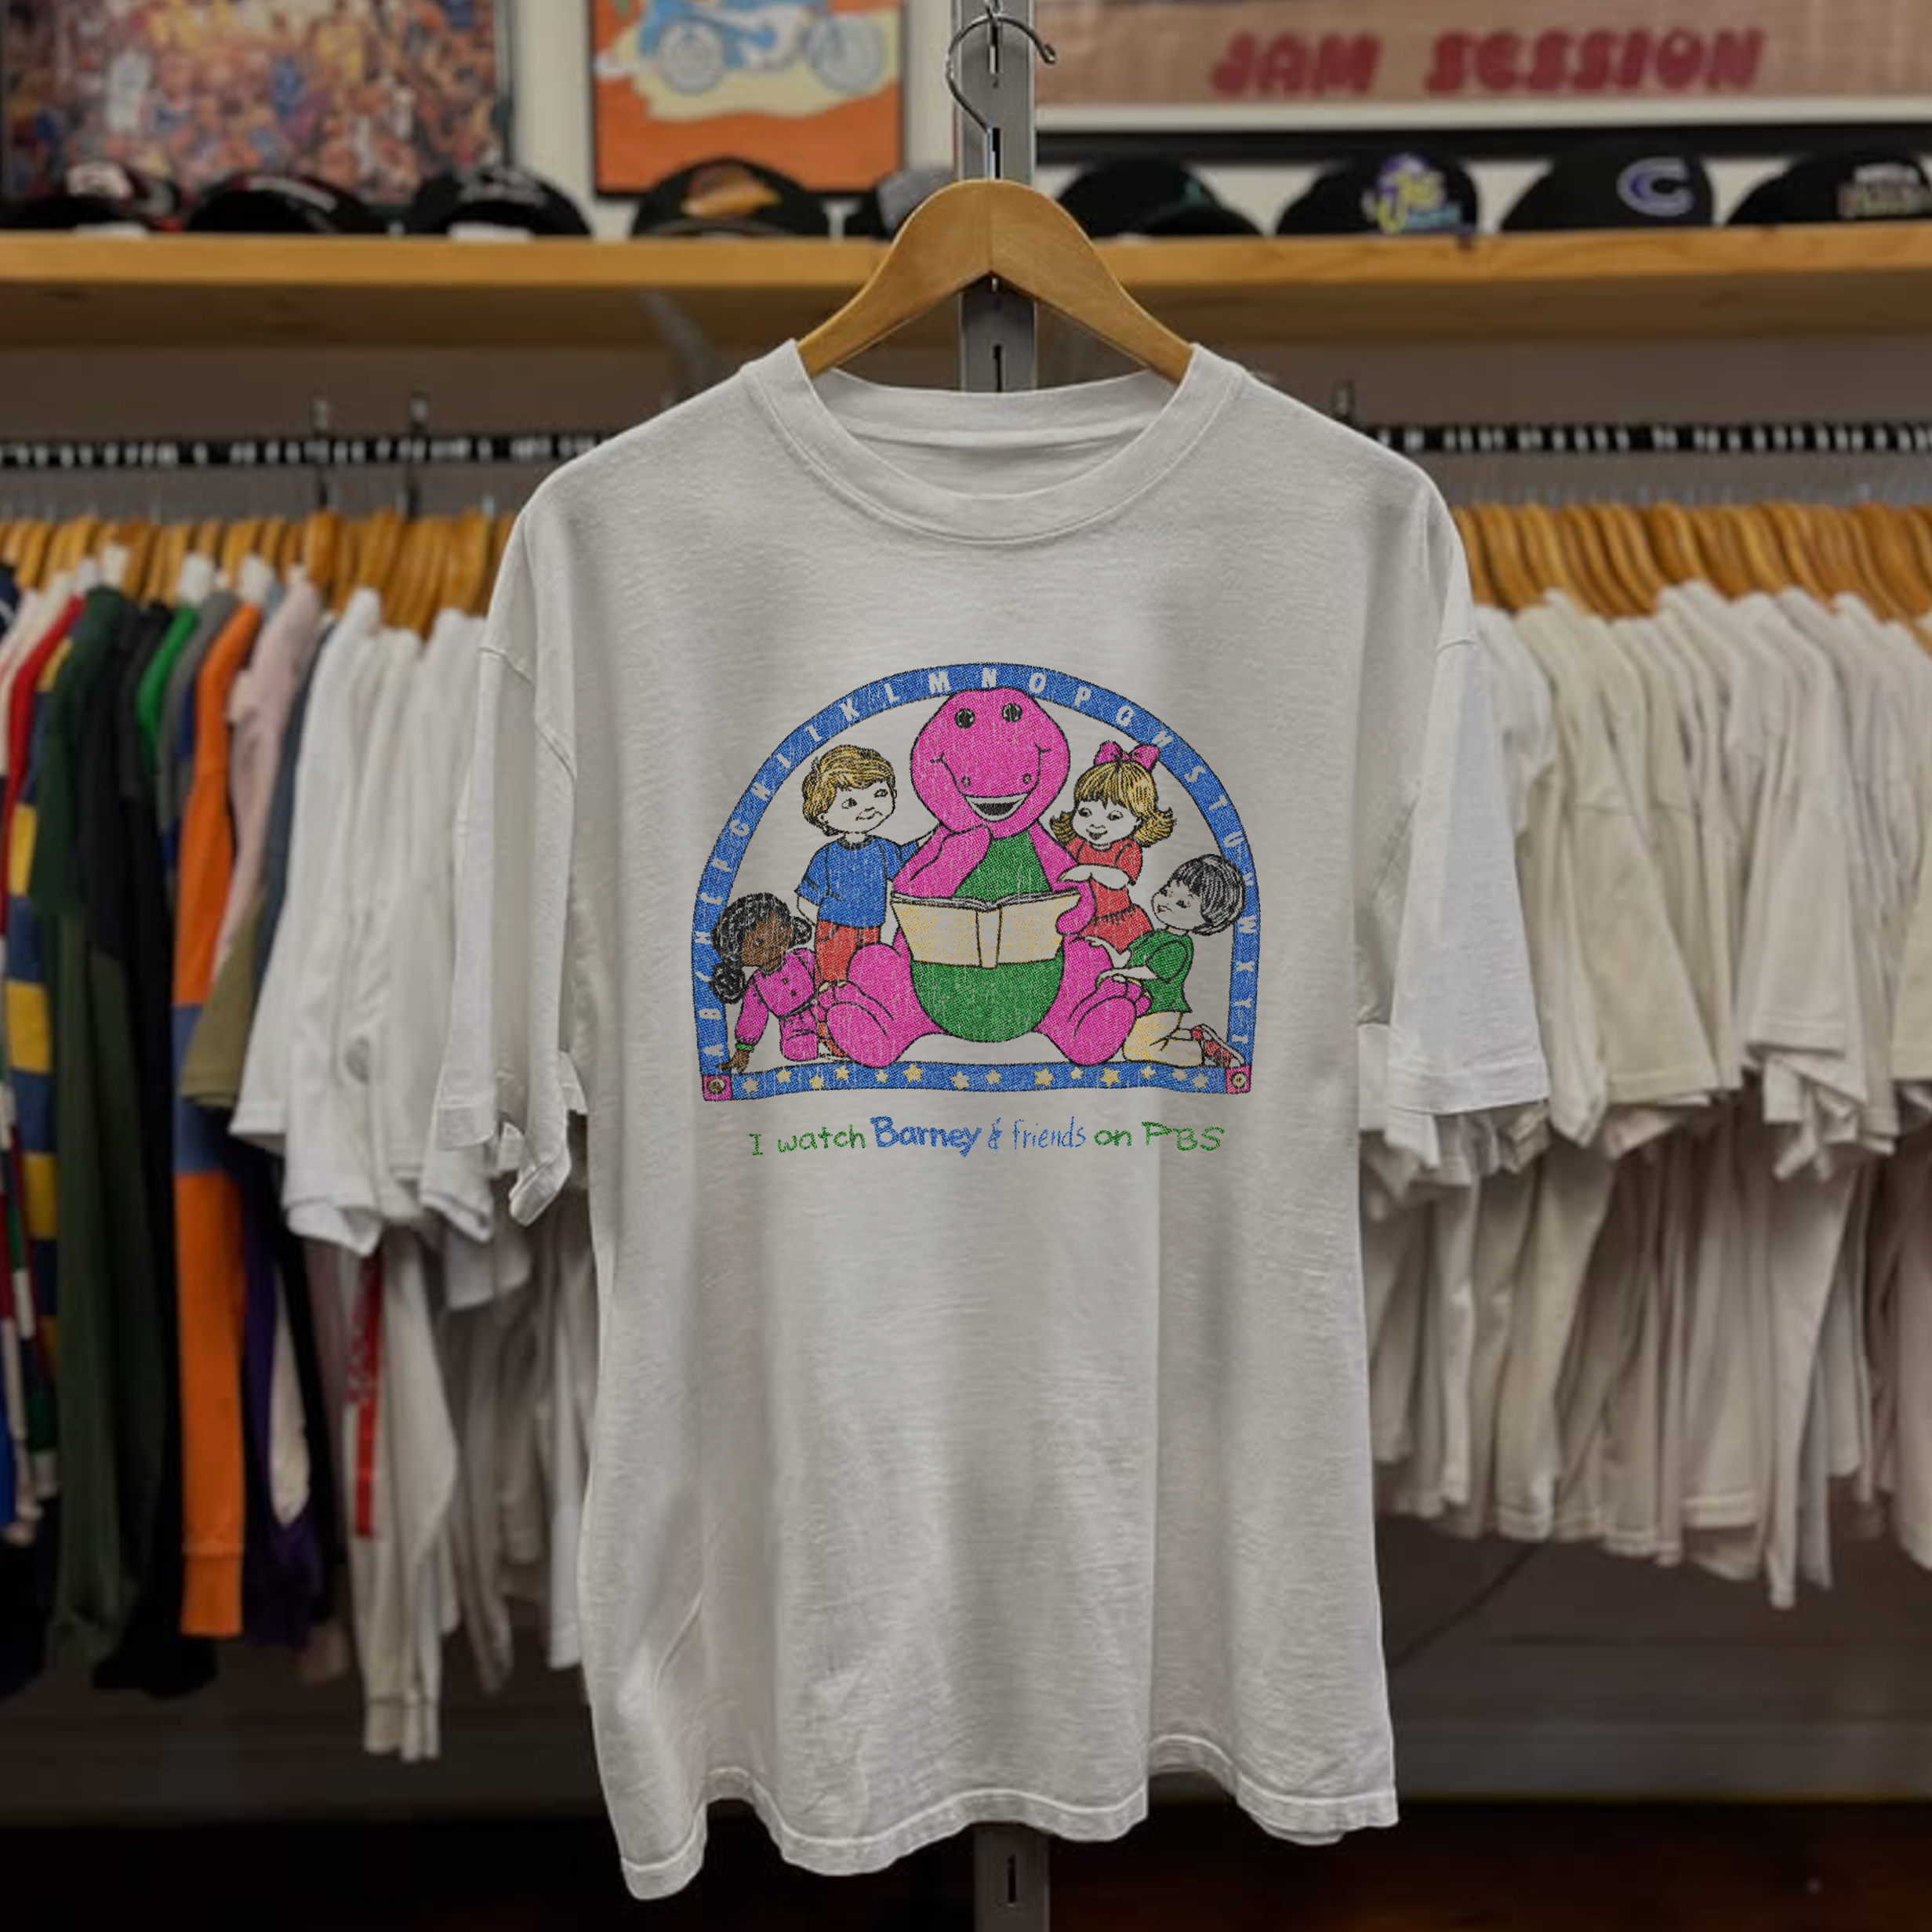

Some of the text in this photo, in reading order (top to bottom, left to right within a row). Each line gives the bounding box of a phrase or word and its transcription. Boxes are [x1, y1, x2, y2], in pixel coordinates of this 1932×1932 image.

[1210, 27, 1765, 97] JAM SESSION
[884, 683, 899, 703] L
[928, 671, 951, 694] M
[982, 667, 997, 688] N
[1029, 673, 1046, 693] O
[1075, 685, 1091, 706] P
[749, 1134, 764, 1156] I
[777, 1124, 866, 1153] watch
[870, 1116, 982, 1157] Barney
[1012, 1117, 1086, 1149] friends
[1094, 1129, 1131, 1146] on
[1141, 1121, 1226, 1151] PBS
